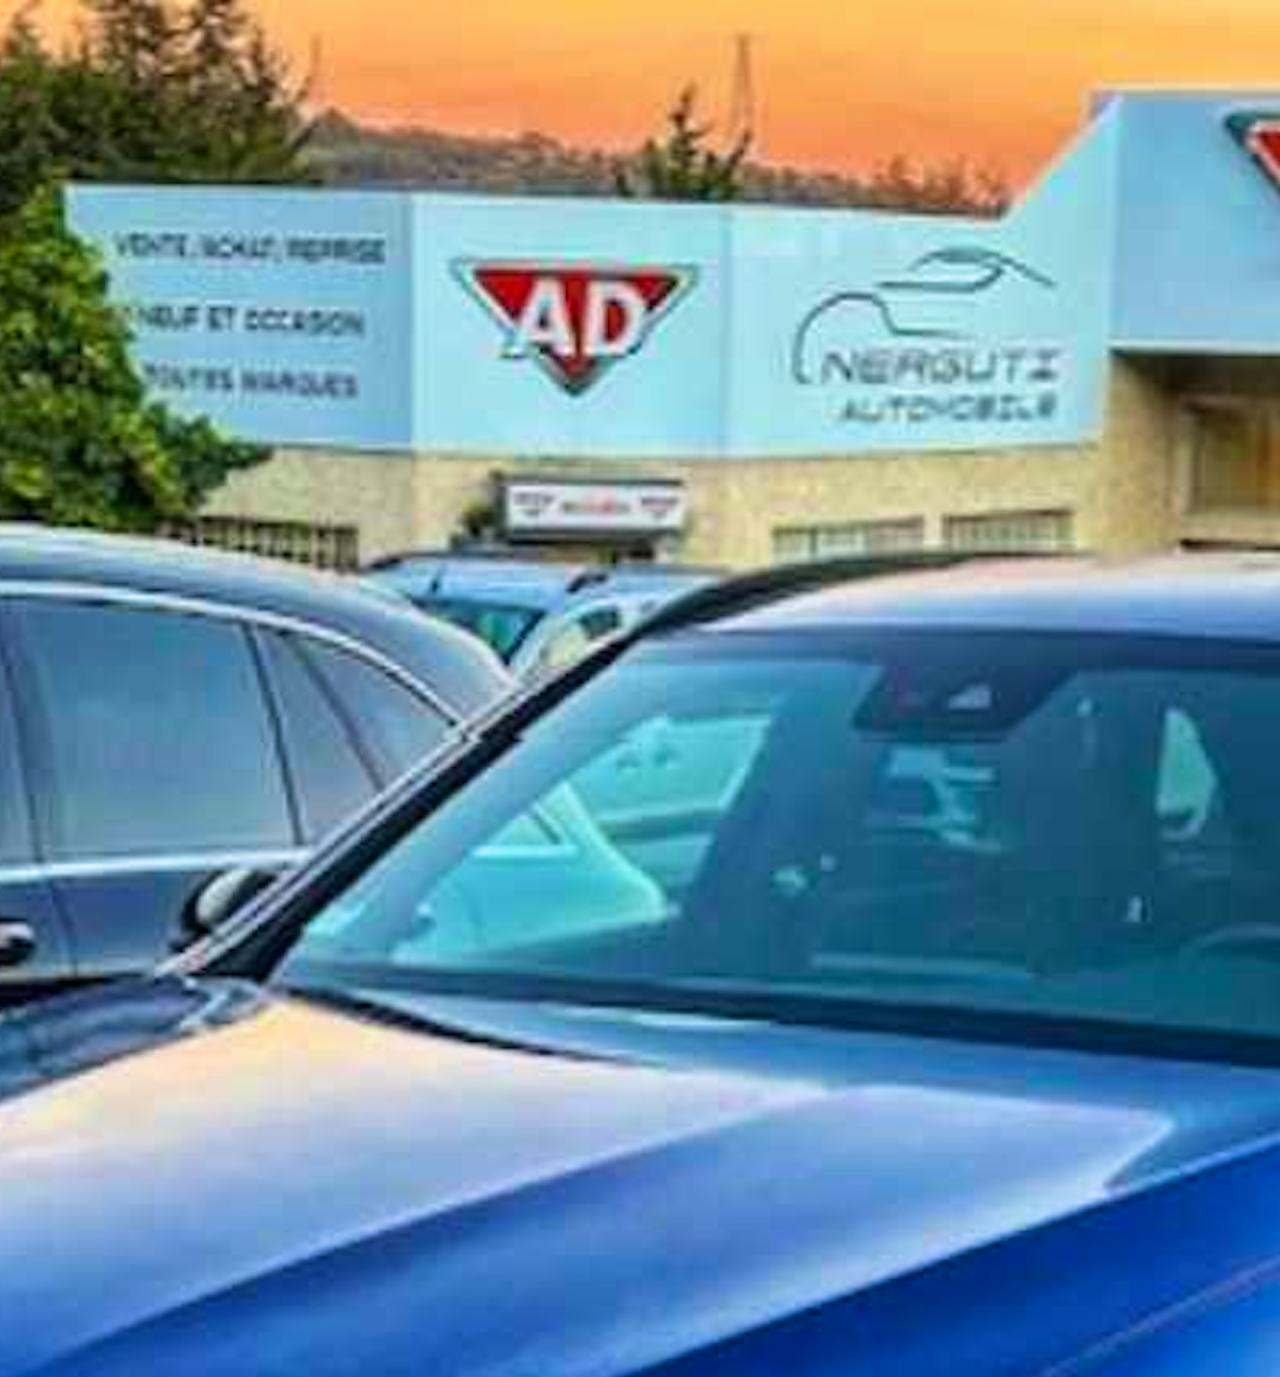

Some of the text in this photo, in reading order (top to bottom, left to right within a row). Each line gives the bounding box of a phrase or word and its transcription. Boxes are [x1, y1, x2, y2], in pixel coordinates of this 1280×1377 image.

[286, 237, 387, 264] REPRISE
[208, 305, 234, 332] ET
[244, 307, 365, 337] OCCASION
[499, 277, 649, 358] AD
[821, 349, 1062, 387] NERGUTI
[238, 369, 358, 400] MARQUES
[839, 391, 1058, 424] AUTOMOBILE
